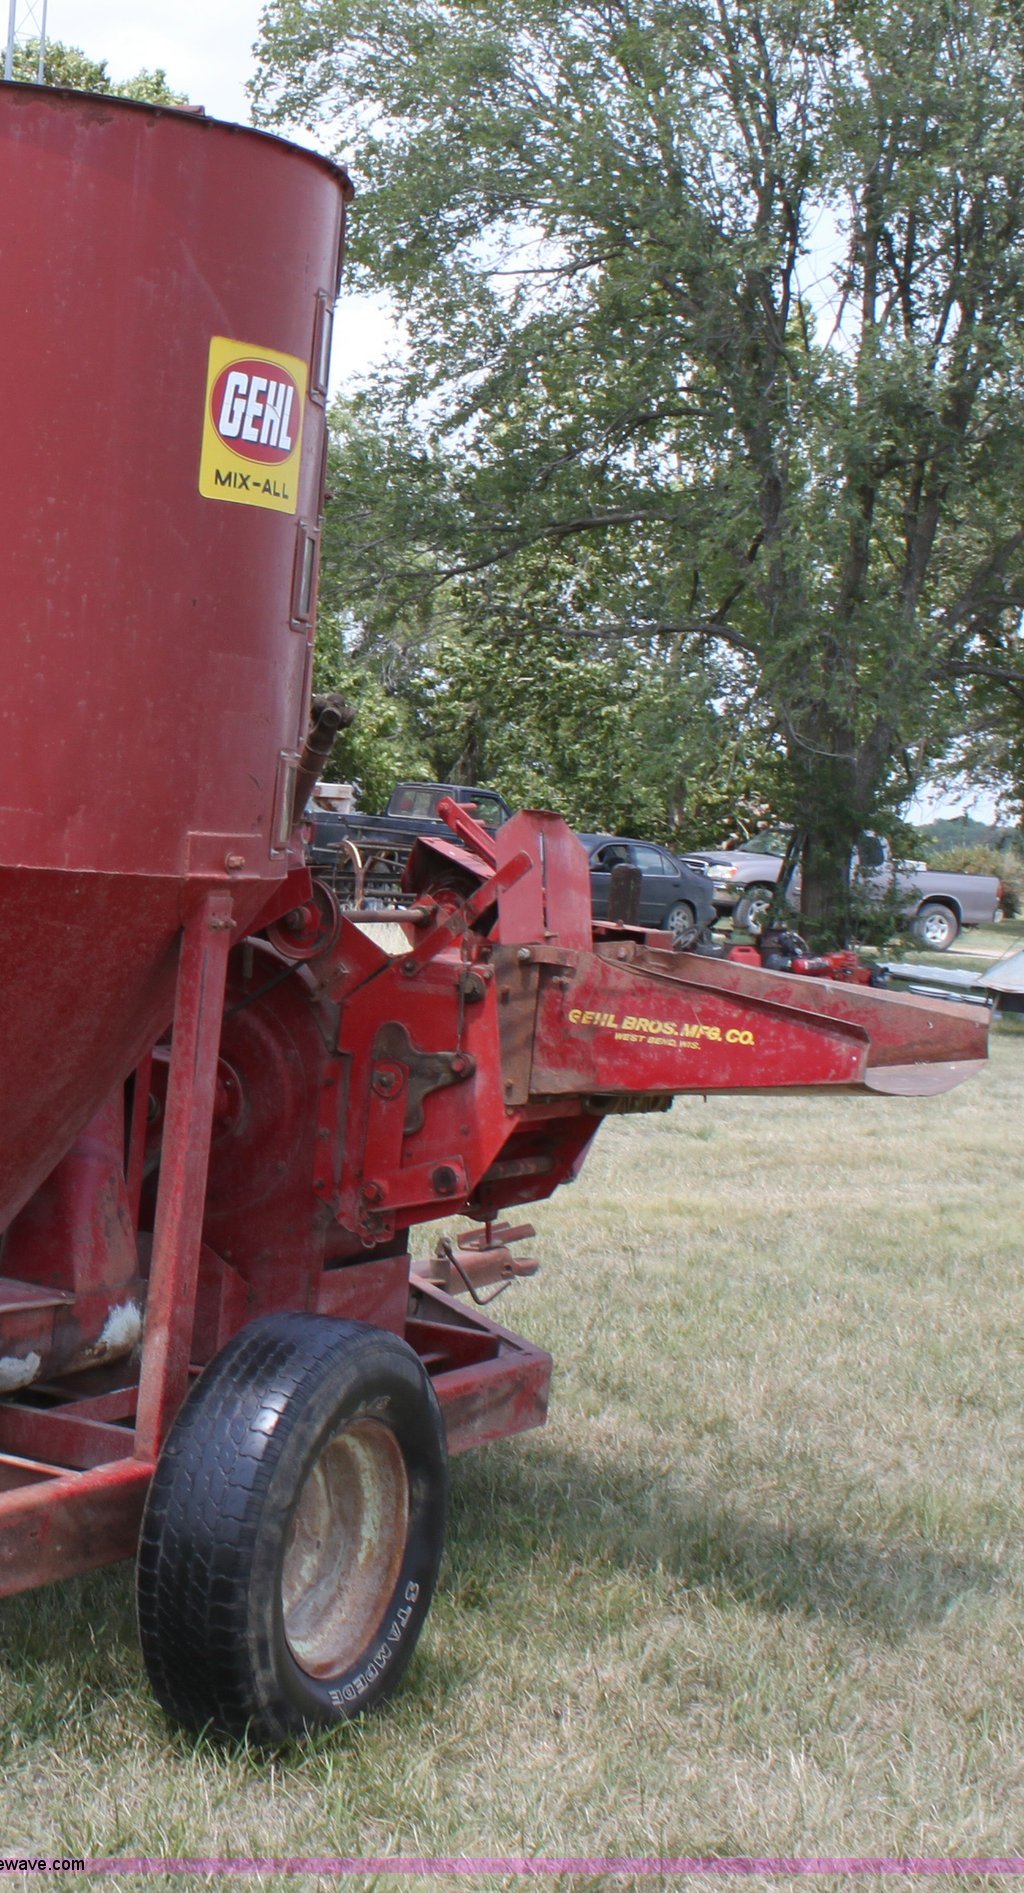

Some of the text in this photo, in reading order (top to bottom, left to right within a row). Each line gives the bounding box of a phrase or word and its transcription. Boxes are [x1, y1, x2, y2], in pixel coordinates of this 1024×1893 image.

[218, 371, 295, 451] GEHL
[214, 469, 289, 499] MIX-ALL
[568, 1008, 755, 1046] GEHL BROS. MFG. CO.
[614, 1032, 645, 1043] WEST
[329, 1580, 420, 1706] STAMPEDE
